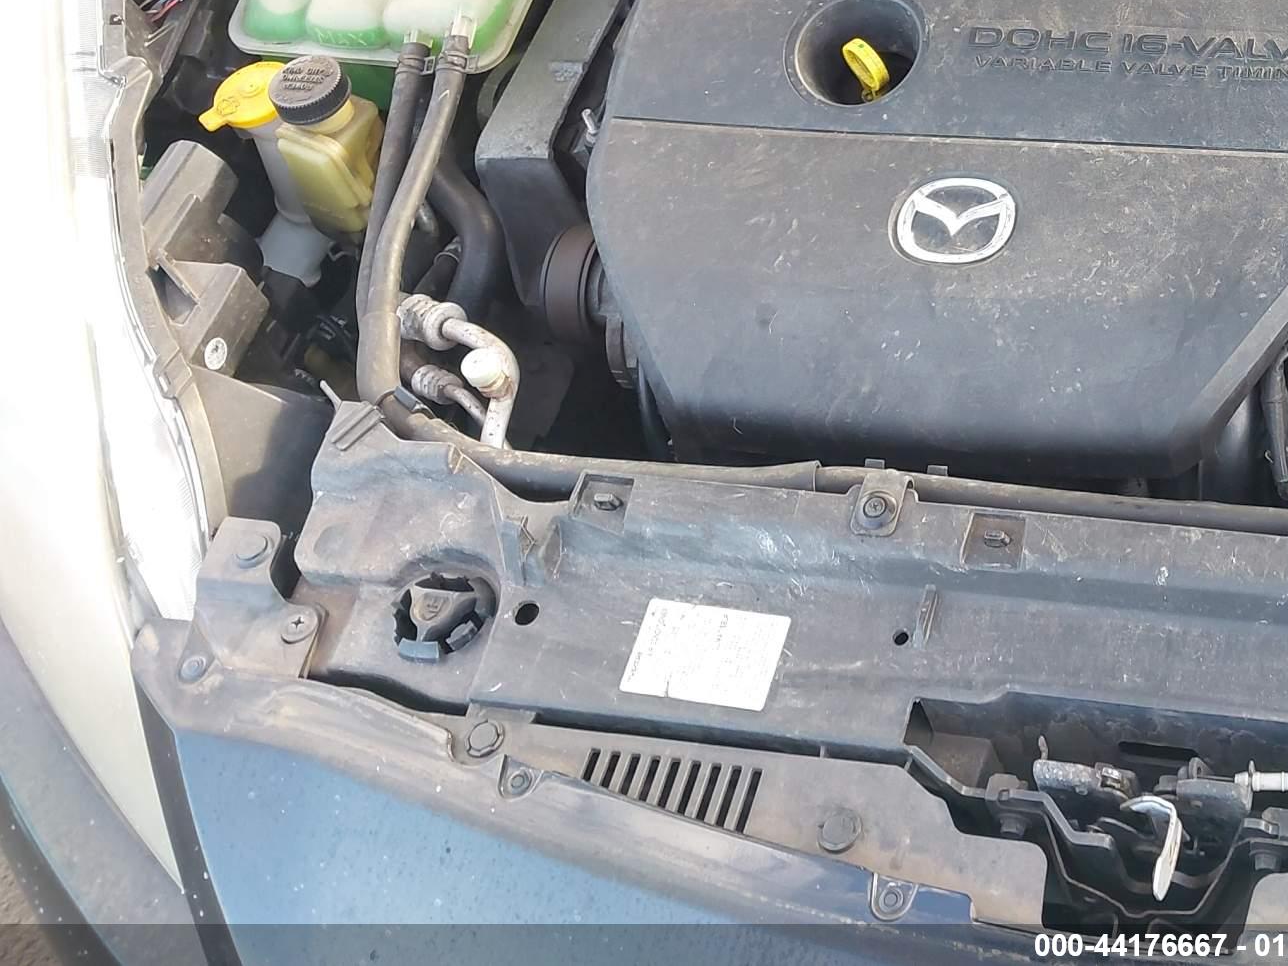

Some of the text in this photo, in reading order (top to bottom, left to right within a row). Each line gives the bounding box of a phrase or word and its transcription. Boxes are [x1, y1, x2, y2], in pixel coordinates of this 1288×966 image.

[968, 26, 1113, 53] DOHC
[974, 55, 1113, 74] VARIABLE
[1121, 60, 1208, 79] VALVE
